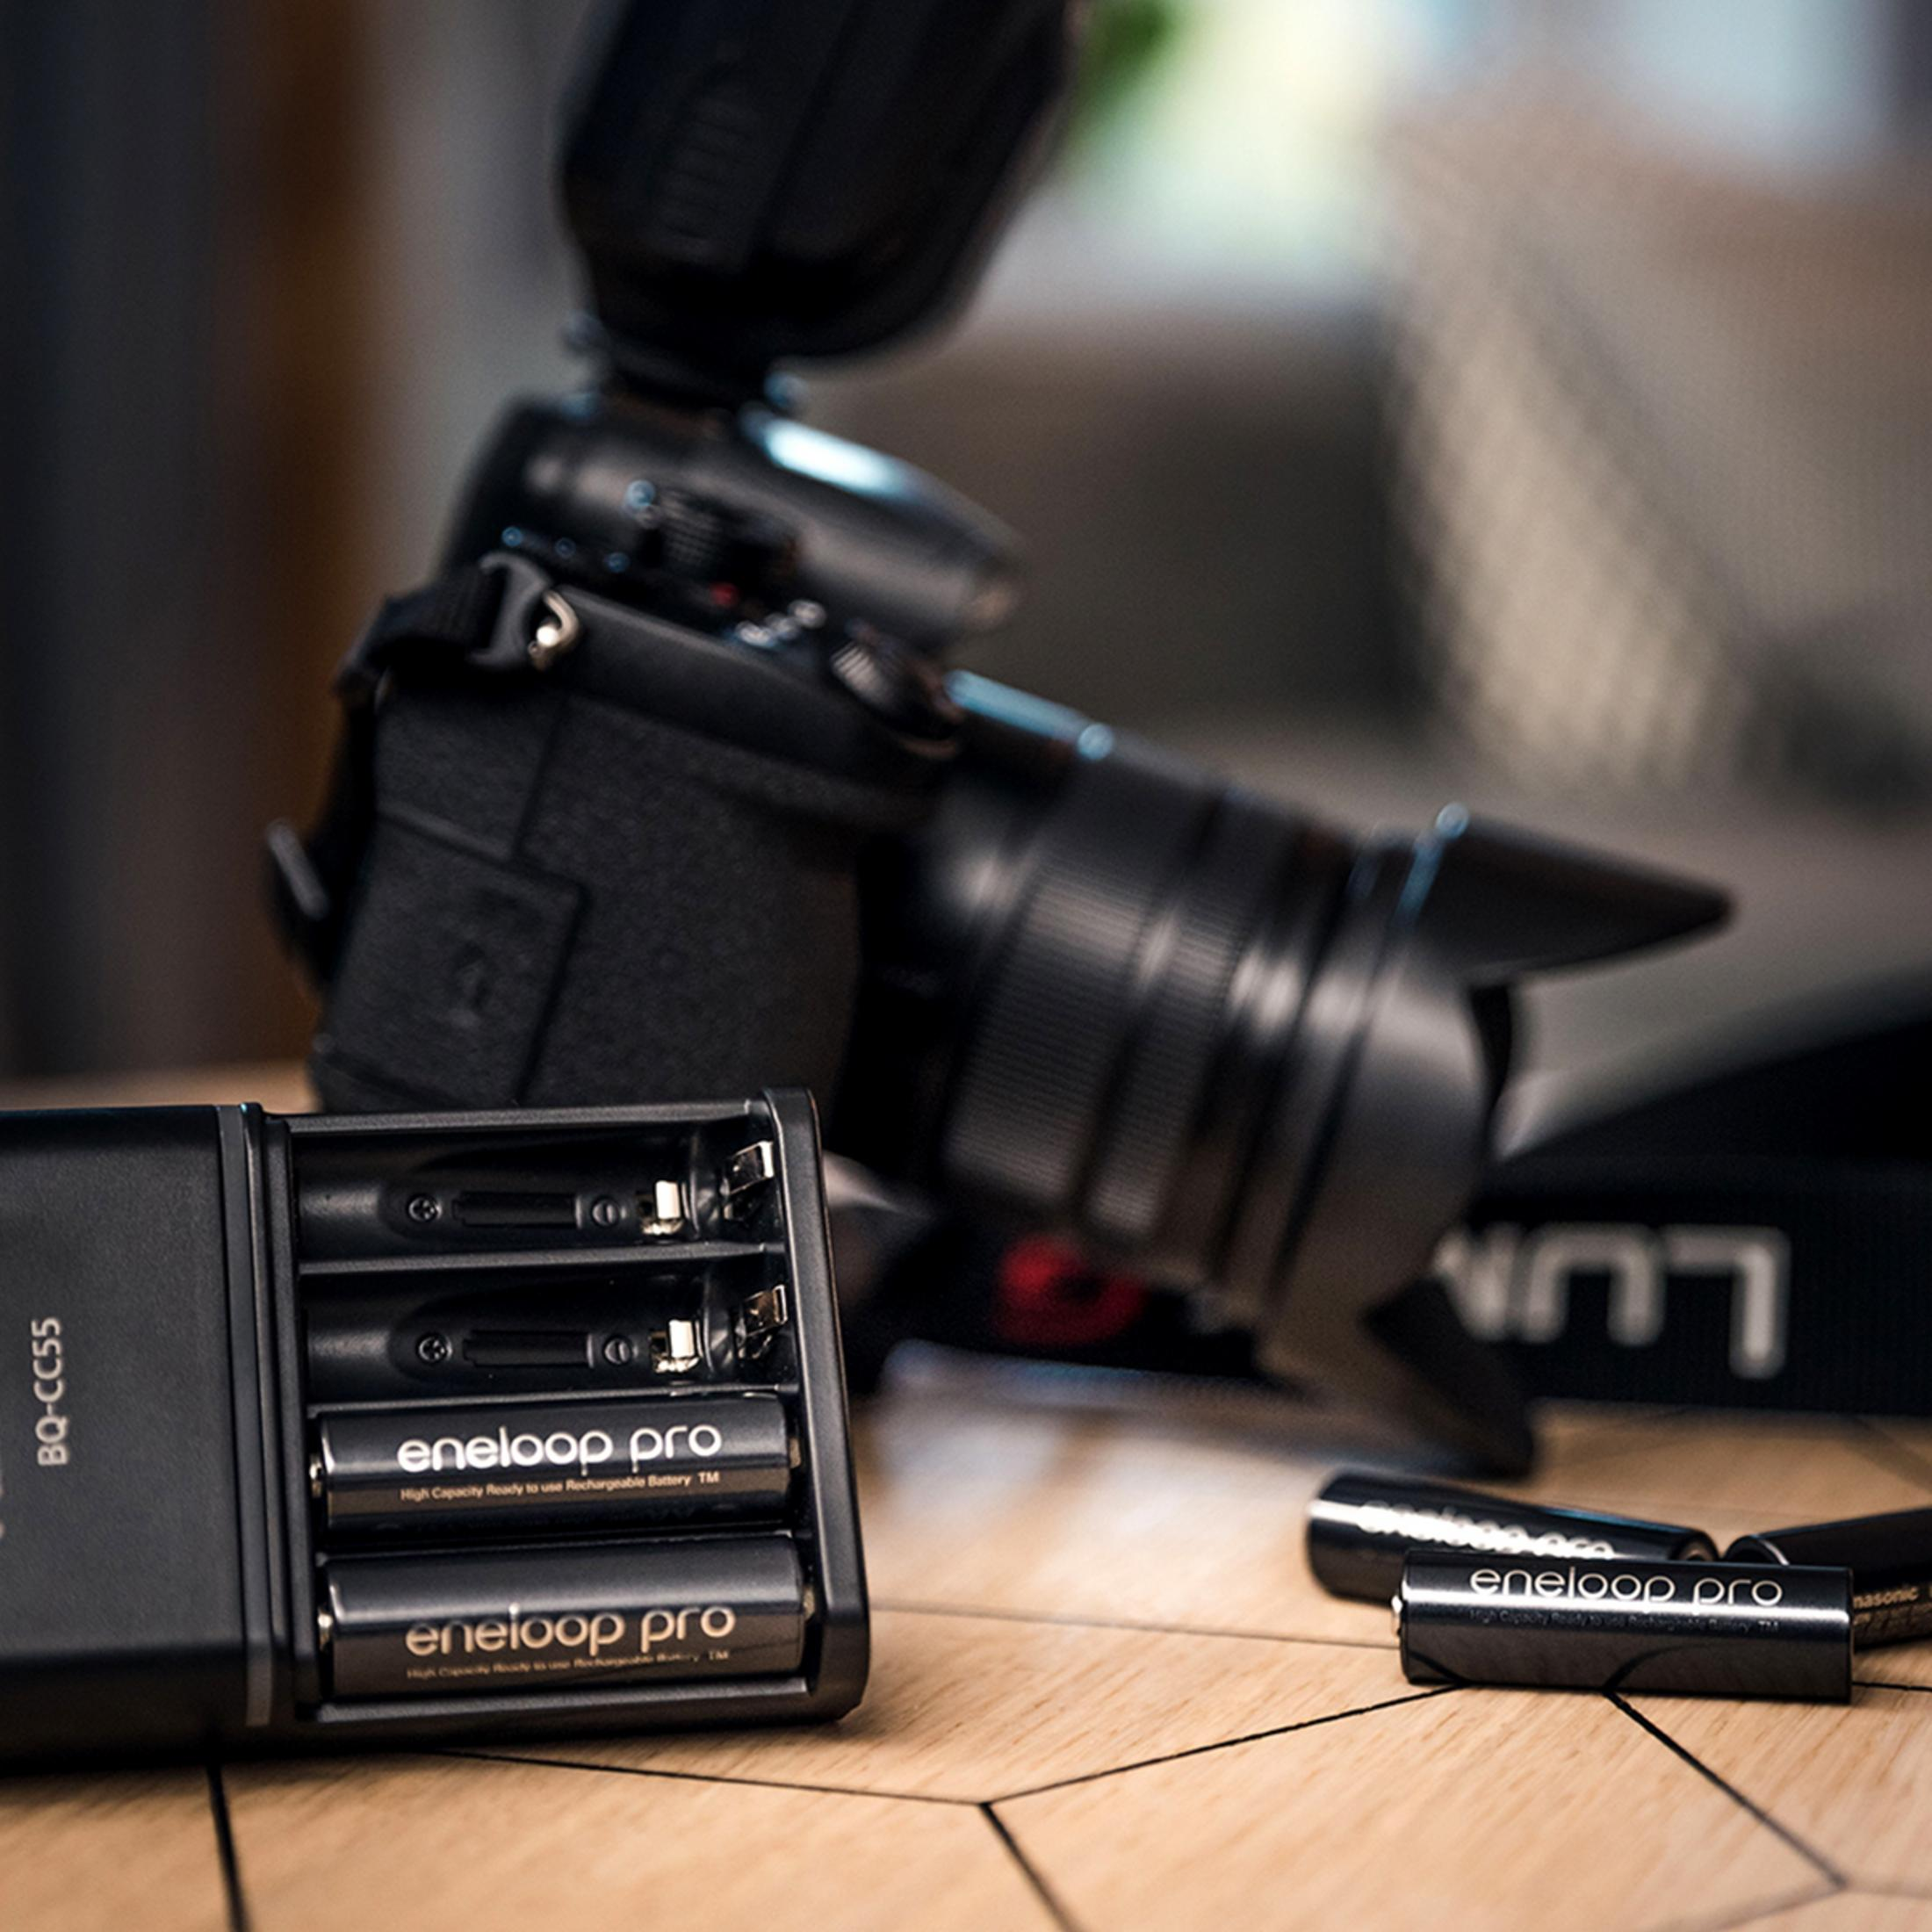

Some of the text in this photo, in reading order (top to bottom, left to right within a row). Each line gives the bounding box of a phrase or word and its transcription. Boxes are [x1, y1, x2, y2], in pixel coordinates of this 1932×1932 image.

[31, 1317, 68, 1466] BQ-CC55
[397, 1424, 723, 1476] eneloop pro
[400, 1471, 720, 1502] High Capacity Ready to use Rechargeable Battery TM
[1470, 1566, 1783, 1616] eneloop pro
[1853, 1586, 1919, 1610] nasonic
[405, 1603, 736, 1655] eneloop pro
